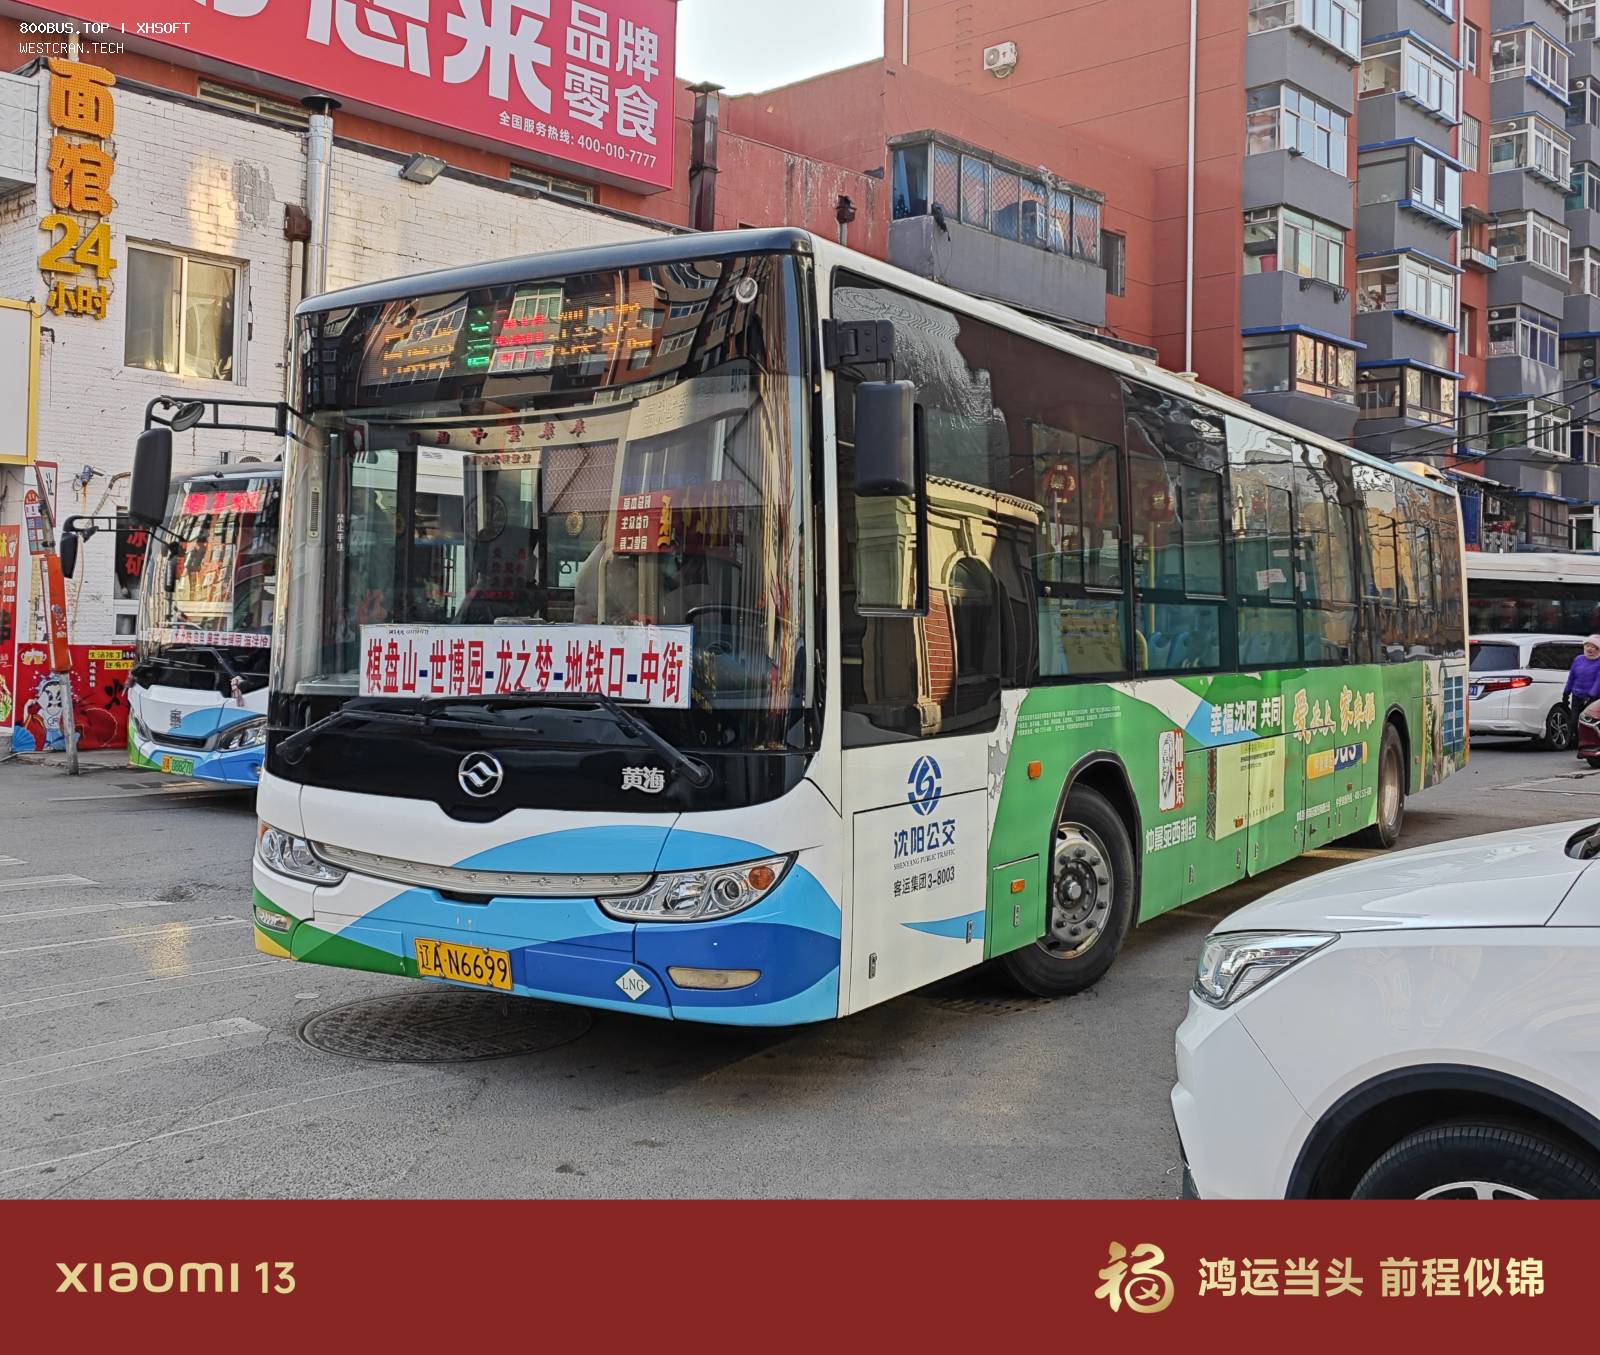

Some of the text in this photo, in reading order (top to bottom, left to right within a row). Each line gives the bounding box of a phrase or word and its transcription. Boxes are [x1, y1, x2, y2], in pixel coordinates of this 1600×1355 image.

[566, 1, 659, 84] 品牌
[564, 60, 657, 146] 零食
[48, 57, 117, 216] 面馆
[577, 135, 657, 168] 400-010-7777
[38, 213, 118, 279] 24
[46, 280, 108, 320] 小时
[1210, 696, 1281, 736] 幸福沈阳 共同
[621, 766, 665, 793] 黄海
[893, 819, 956, 860] 沈阳公交
[1145, 816, 1197, 855] 仲景宛西制药
[893, 849, 956, 871] SHENYANG PUBLIC TRAFFIC
[621, 977, 645, 992] LNG
